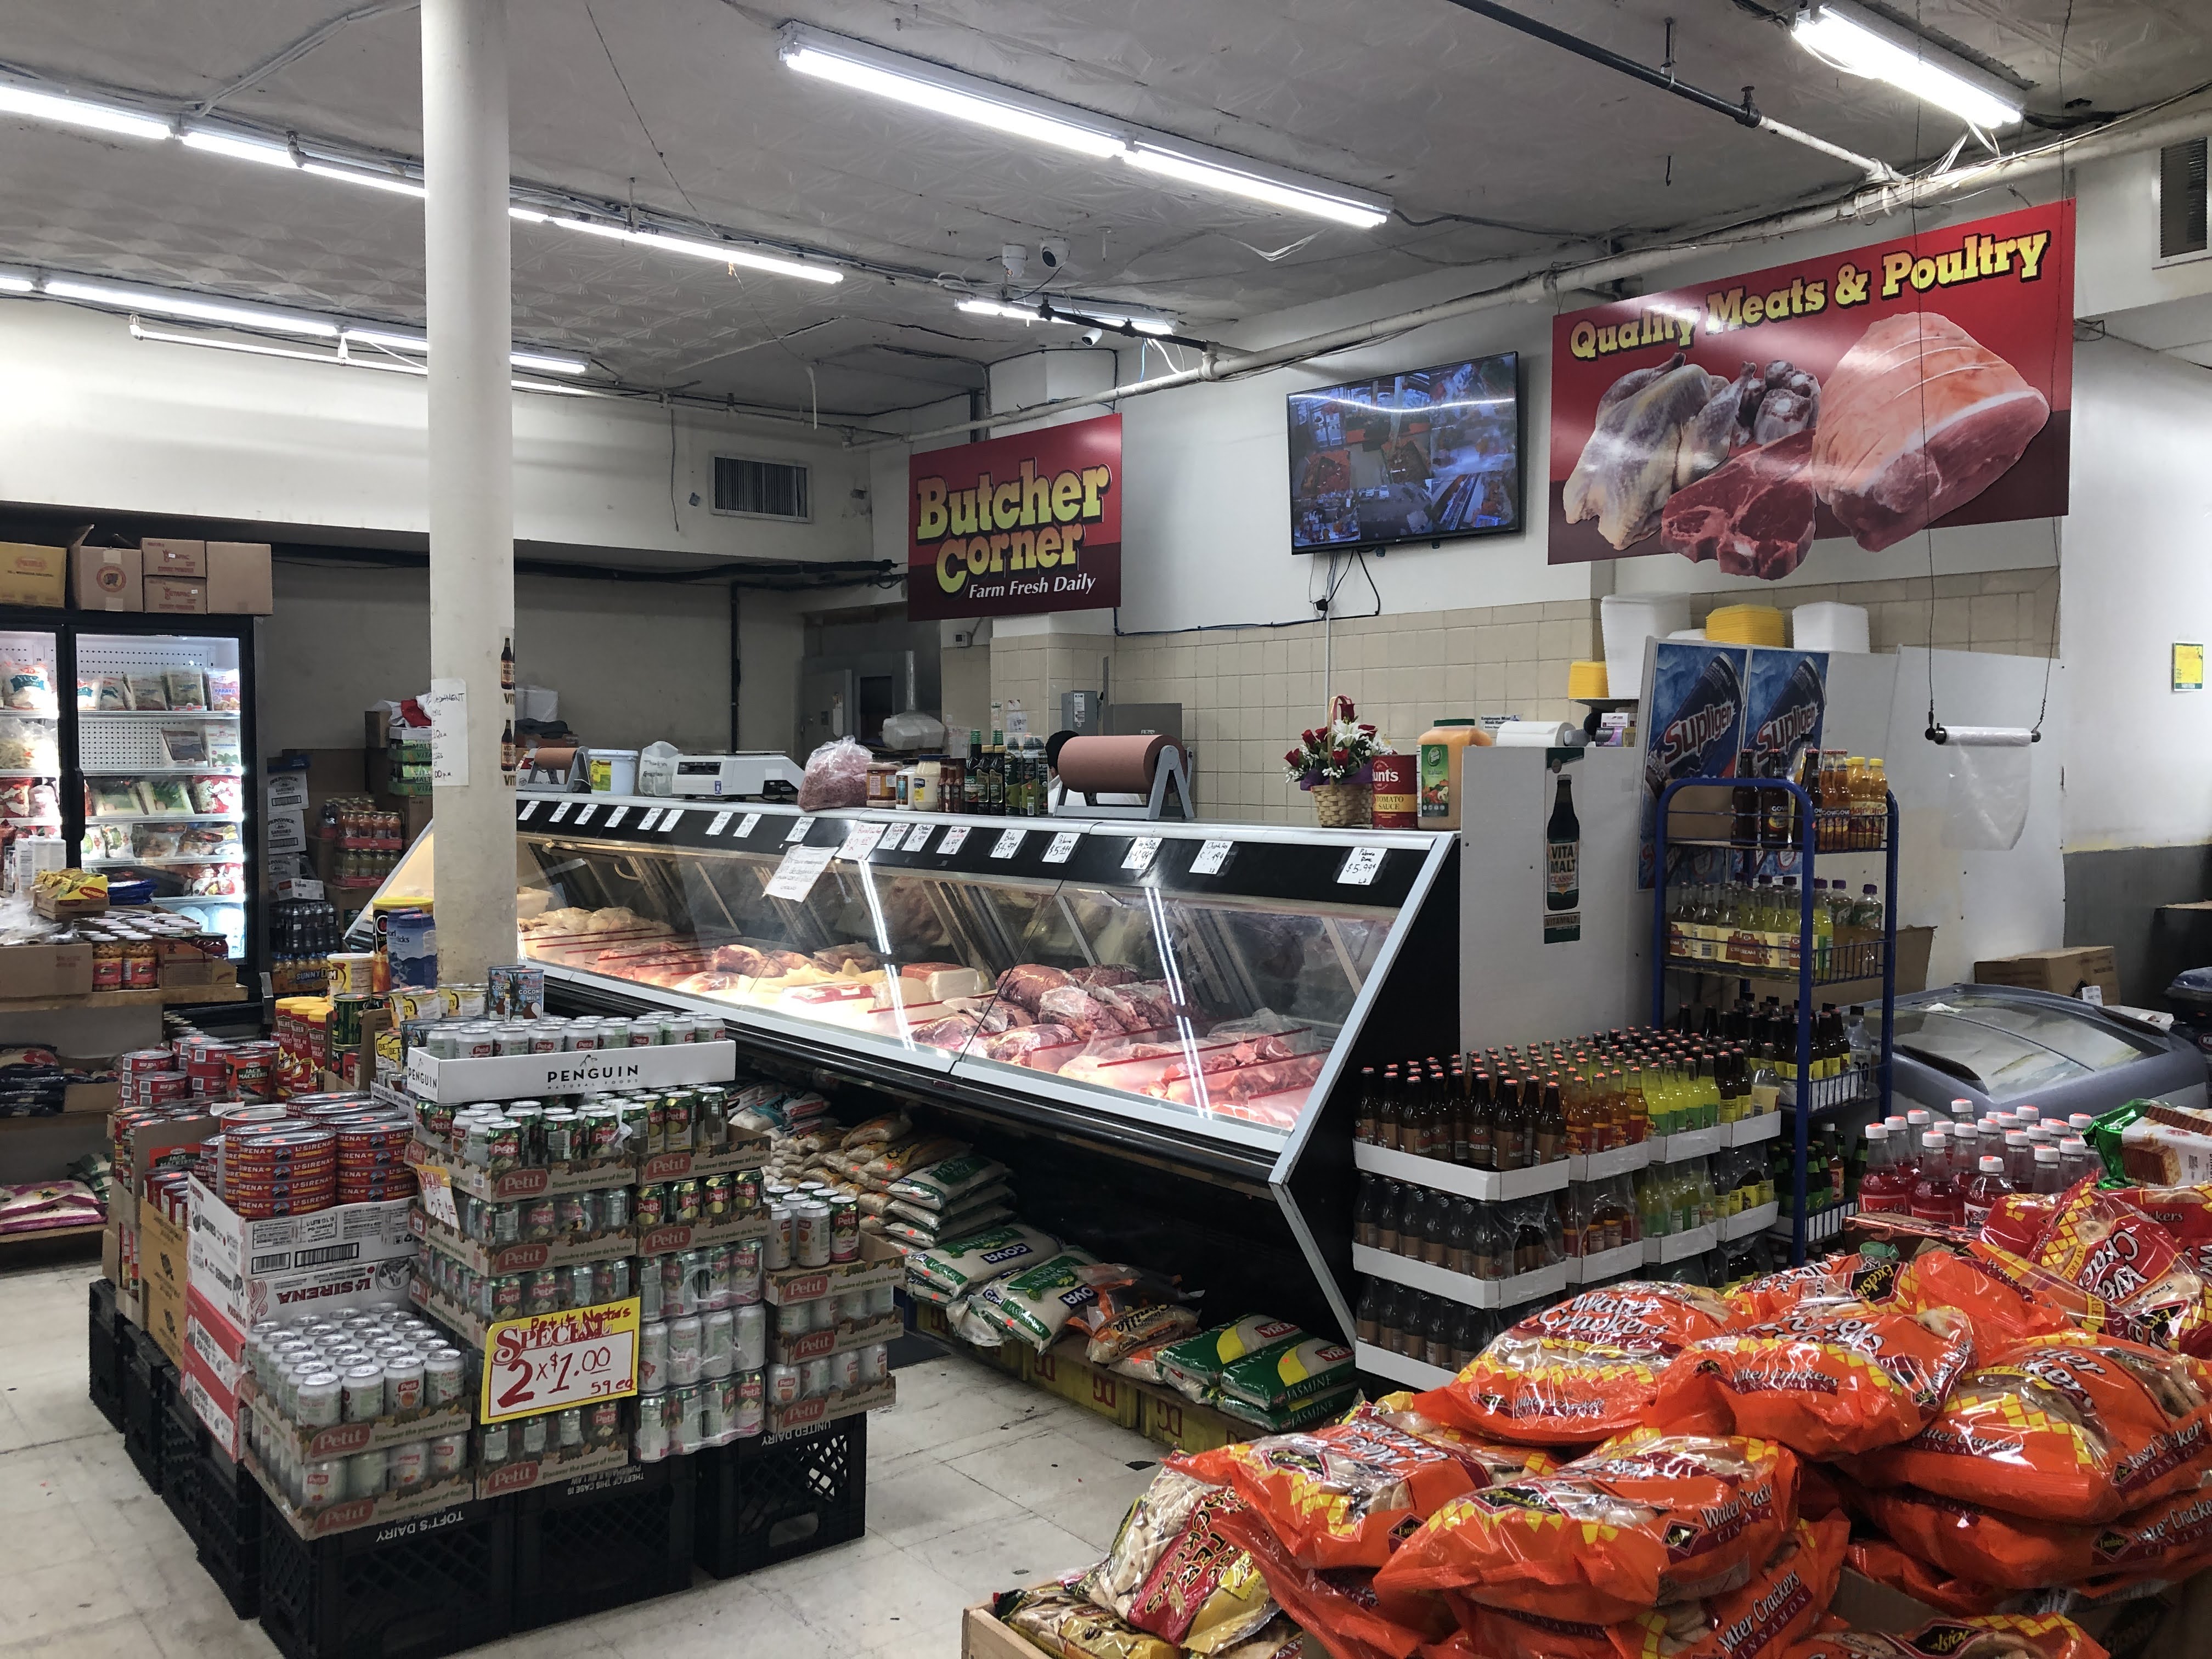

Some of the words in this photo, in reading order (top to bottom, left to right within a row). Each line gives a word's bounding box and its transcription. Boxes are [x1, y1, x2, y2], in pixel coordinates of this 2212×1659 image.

[1570, 304, 1701, 360] Quality
[1706, 276, 1825, 334] Meats
[1835, 264, 1869, 307] &
[1882, 230, 2051, 300] Poultry
[917, 458, 1111, 543] Butcher
[936, 524, 1085, 598] Corner
[969, 584, 1005, 599] Farm
[1009, 577, 1048, 596] Fresh
[1053, 573, 1096, 596] Daily
[1664, 698, 1736, 765] Supligen
[1757, 702, 1820, 764] Supligen
[1551, 845, 1574, 859] VITA
[1550, 860, 1576, 874] MALT
[1544, 915, 1578, 927] VITAMALT
[296, 969, 321, 981] SUNNY
[476, 1046, 490, 1054] Petit
[408, 1066, 438, 1090] PENGUIN
[547, 1064, 639, 1084] PENGUIN
[665, 1110, 686, 1120] Petit
[430, 1120, 452, 1130] Petit
[303, 1141, 331, 1150] SIRENA
[302, 1159, 331, 1170] SIRENA
[652, 1158, 686, 1173] Petit
[300, 1178, 330, 1188] SIRENA
[504, 1173, 541, 1191] Petit
[709, 1191, 729, 1201] Petit
[735, 1186, 755, 1195] Petit
[638, 1202, 659, 1211] Petit
[837, 1215, 856, 1225] Petit
[652, 1231, 686, 1247] Petit
[504, 1249, 543, 1266] Petit
[984, 1245, 1028, 1262] GOYA
[276, 1282, 354, 1305] SIRENA
[791, 1280, 821, 1295] Petit
[1063, 1286, 1094, 1305] OYA
[499, 1293, 520, 1304] Petit
[492, 1323, 612, 1366] SPECIAL
[800, 1335, 830, 1353] Petit
[400, 1380, 419, 1391] Petit
[497, 1358, 535, 1408] 2
[1286, 1374, 1331, 1401] JASMINE
[741, 1386, 761, 1397] Petit
[789, 1404, 820, 1419] Petit
[1292, 1400, 1334, 1425] JASMINE
[796, 1420, 832, 1435] UNITED
[319, 1430, 361, 1449] Petit
[761, 1431, 793, 1447] DAIRY
[1921, 1429, 1955, 1443] ater
[494, 1466, 531, 1487] Petit
[1700, 1500, 1740, 1530] Water
[1739, 1482, 1772, 1509] Crack
[419, 1510, 464, 1531] TOFT'S
[375, 1523, 416, 1543] DAIRY
[1753, 1568, 1801, 1623] Crackers
